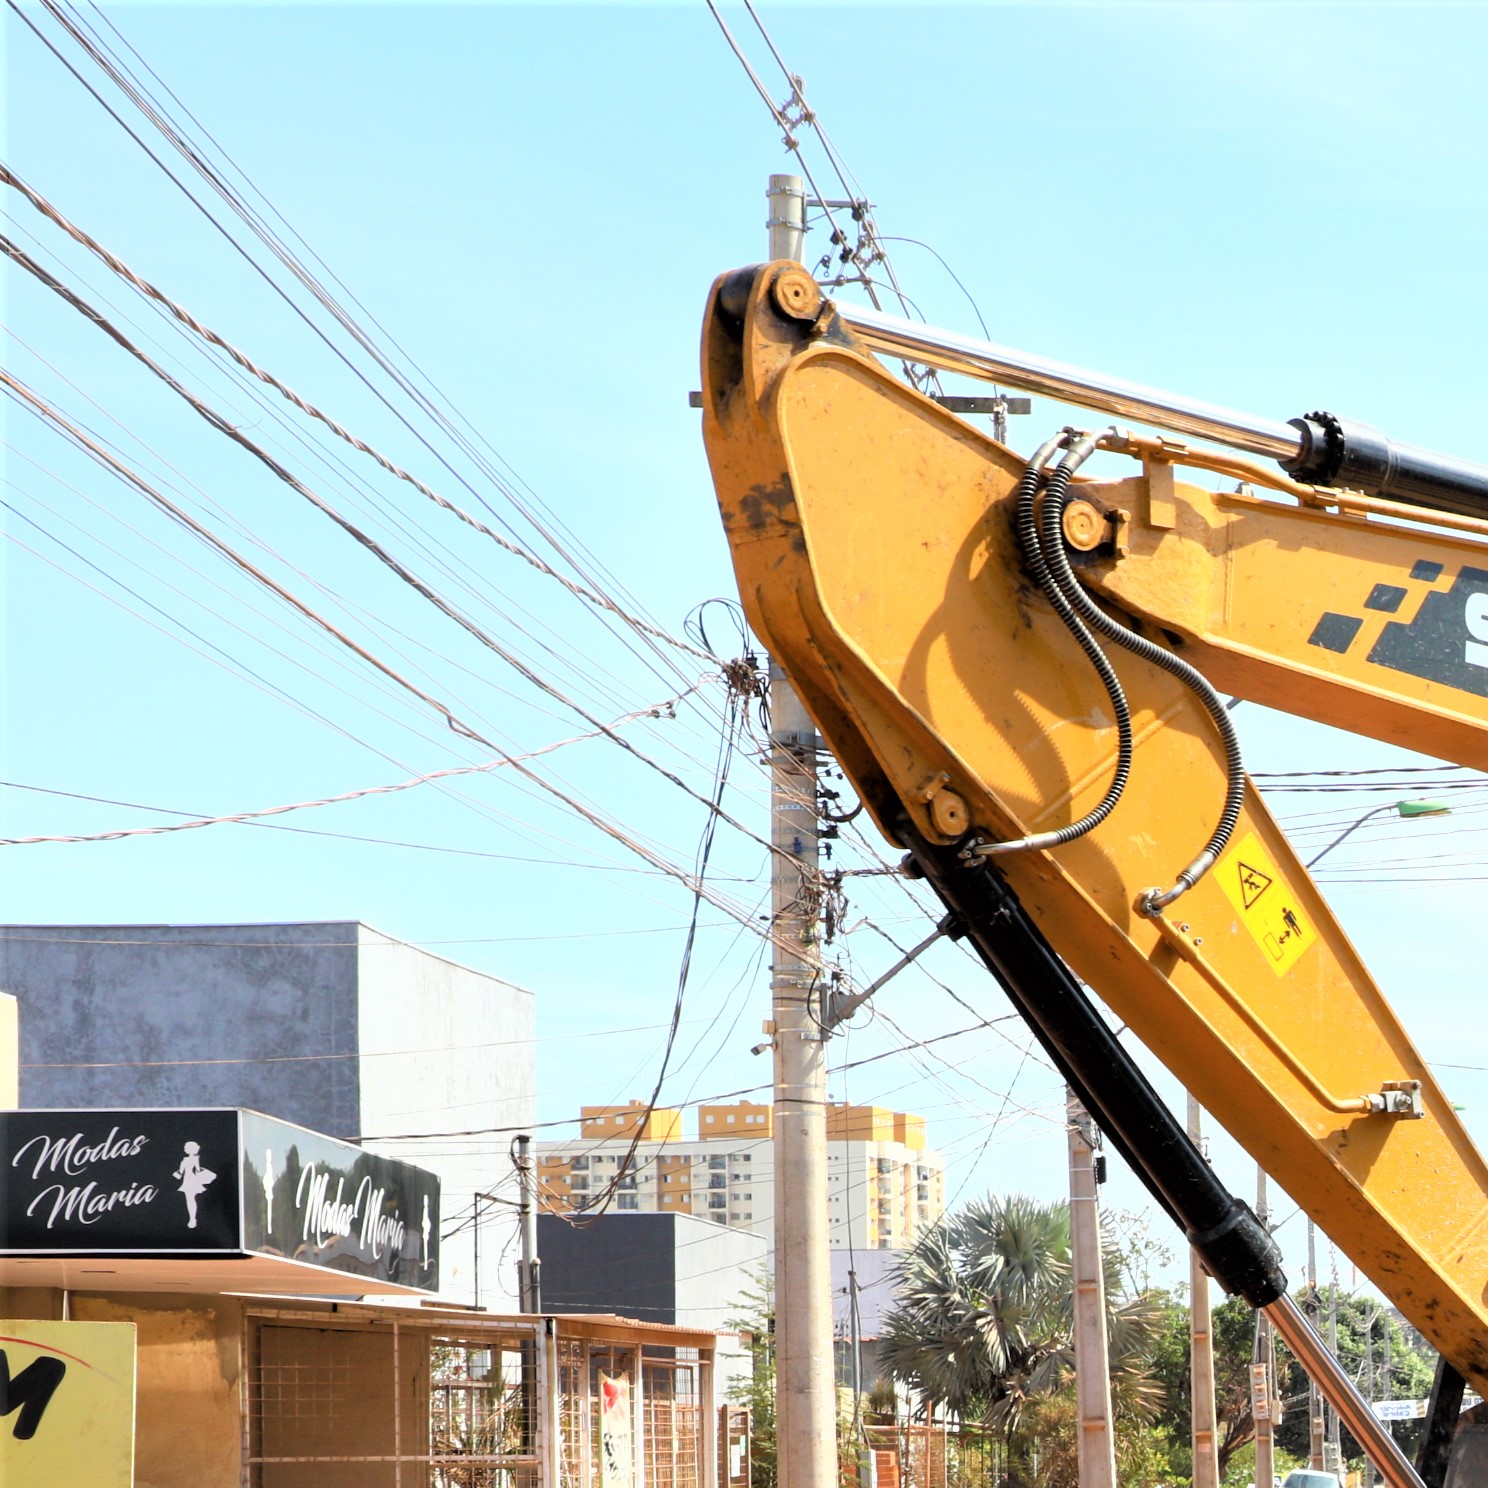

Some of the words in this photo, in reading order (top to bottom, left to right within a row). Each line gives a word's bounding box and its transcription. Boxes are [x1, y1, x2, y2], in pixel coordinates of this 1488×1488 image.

[12, 1126, 150, 1180] Modas
[27, 1178, 159, 1230] Maria
[296, 1161, 354, 1249] Modas
[354, 1175, 405, 1260] Maria
